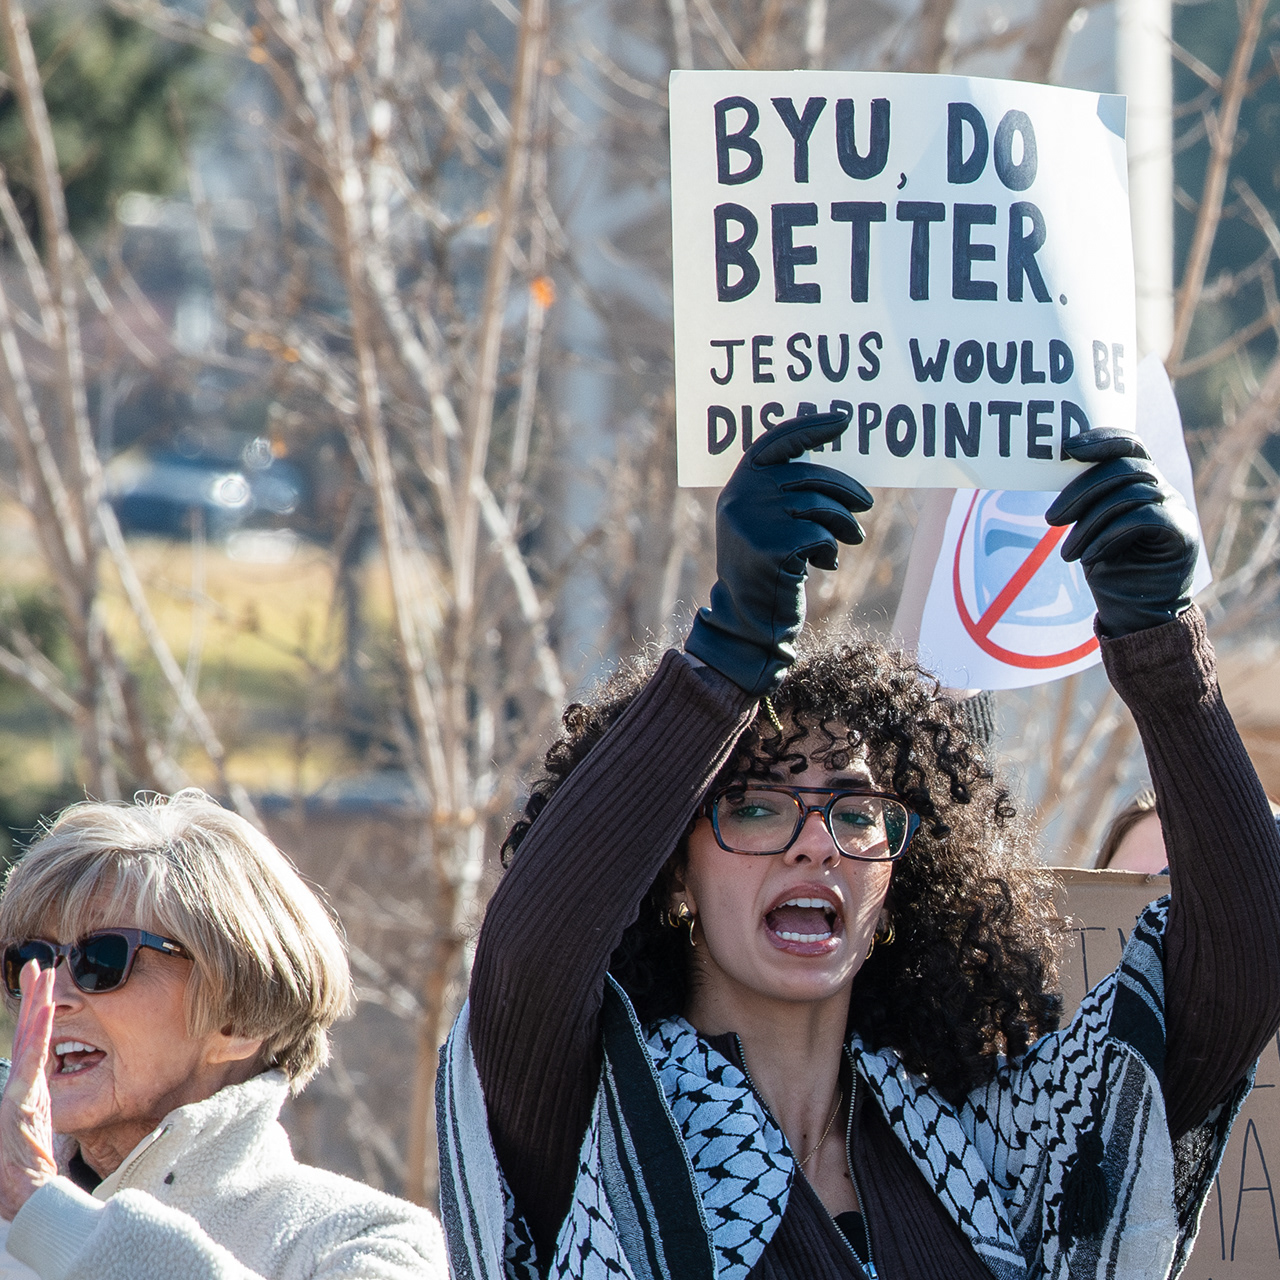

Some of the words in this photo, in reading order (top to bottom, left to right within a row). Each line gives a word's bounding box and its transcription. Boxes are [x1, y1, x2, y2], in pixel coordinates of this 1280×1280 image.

[714, 96, 907, 189] BYU,
[947, 102, 1038, 192] DO
[713, 200, 1069, 306] BETTER.
[710, 331, 884, 385] JESUS
[909, 338, 1075, 385] WOULD
[1092, 339, 1125, 395] BE
